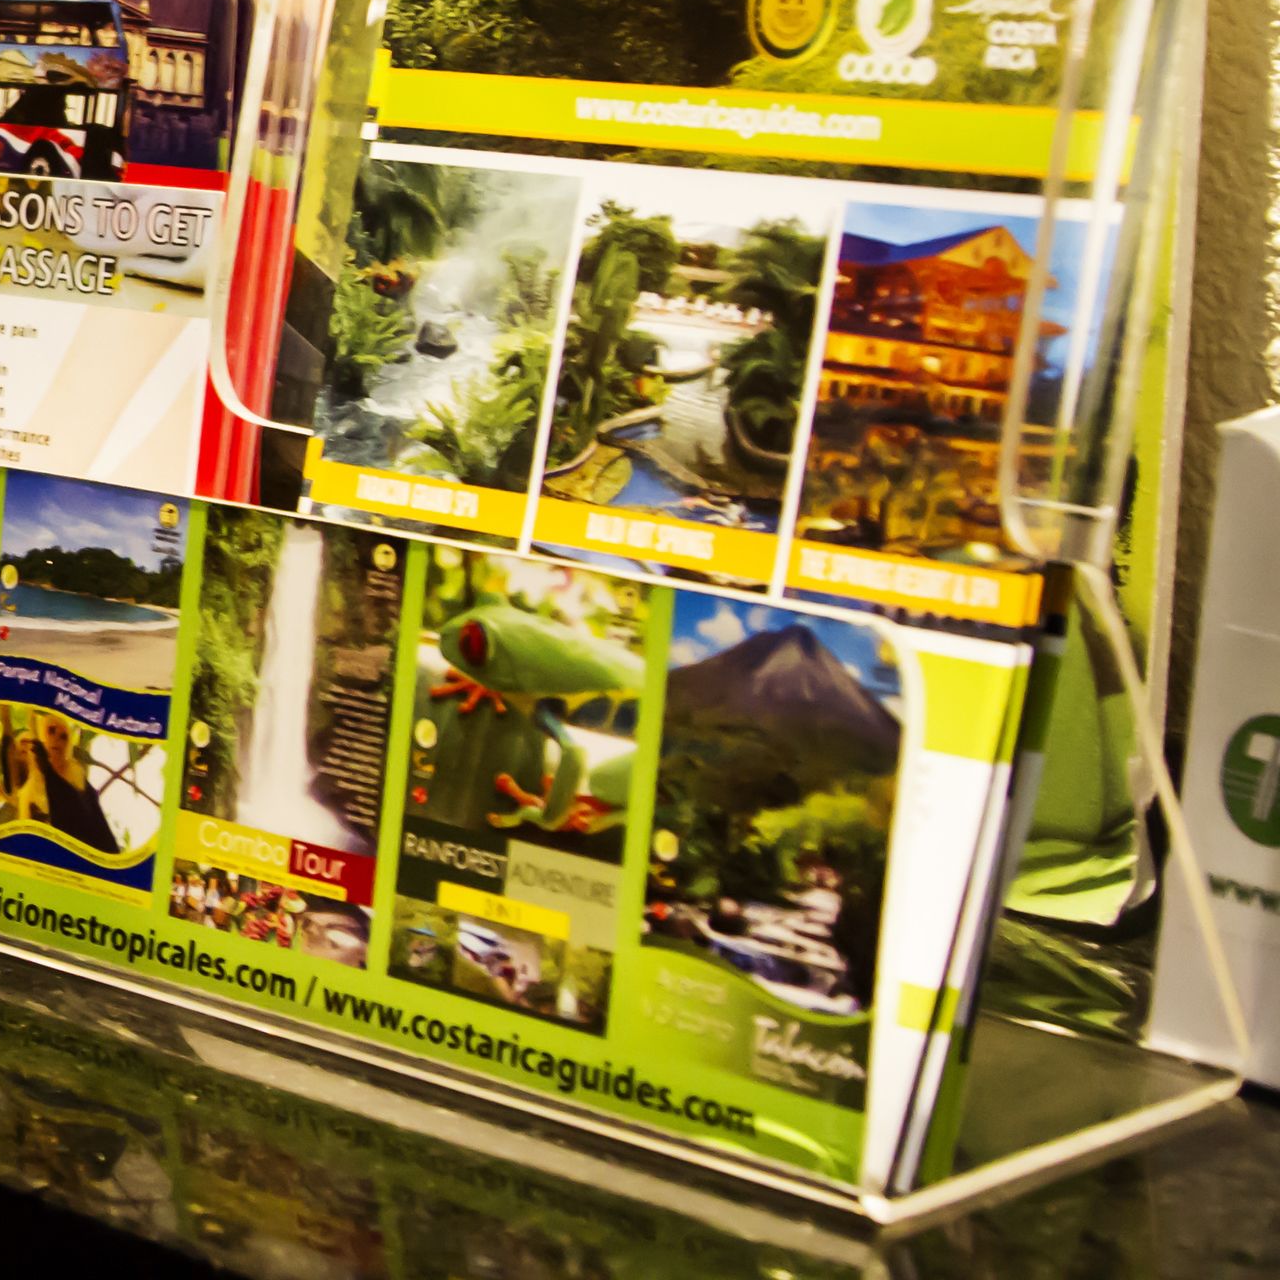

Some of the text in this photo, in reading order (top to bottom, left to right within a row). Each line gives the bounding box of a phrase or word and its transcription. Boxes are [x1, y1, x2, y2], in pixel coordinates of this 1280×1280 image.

[93, 198, 138, 240] TO
[148, 204, 213, 248] GET
[200, 820, 288, 866] Combo
[293, 843, 347, 880] Tour
[322, 986, 757, 1138] www.costaricaguides.com
